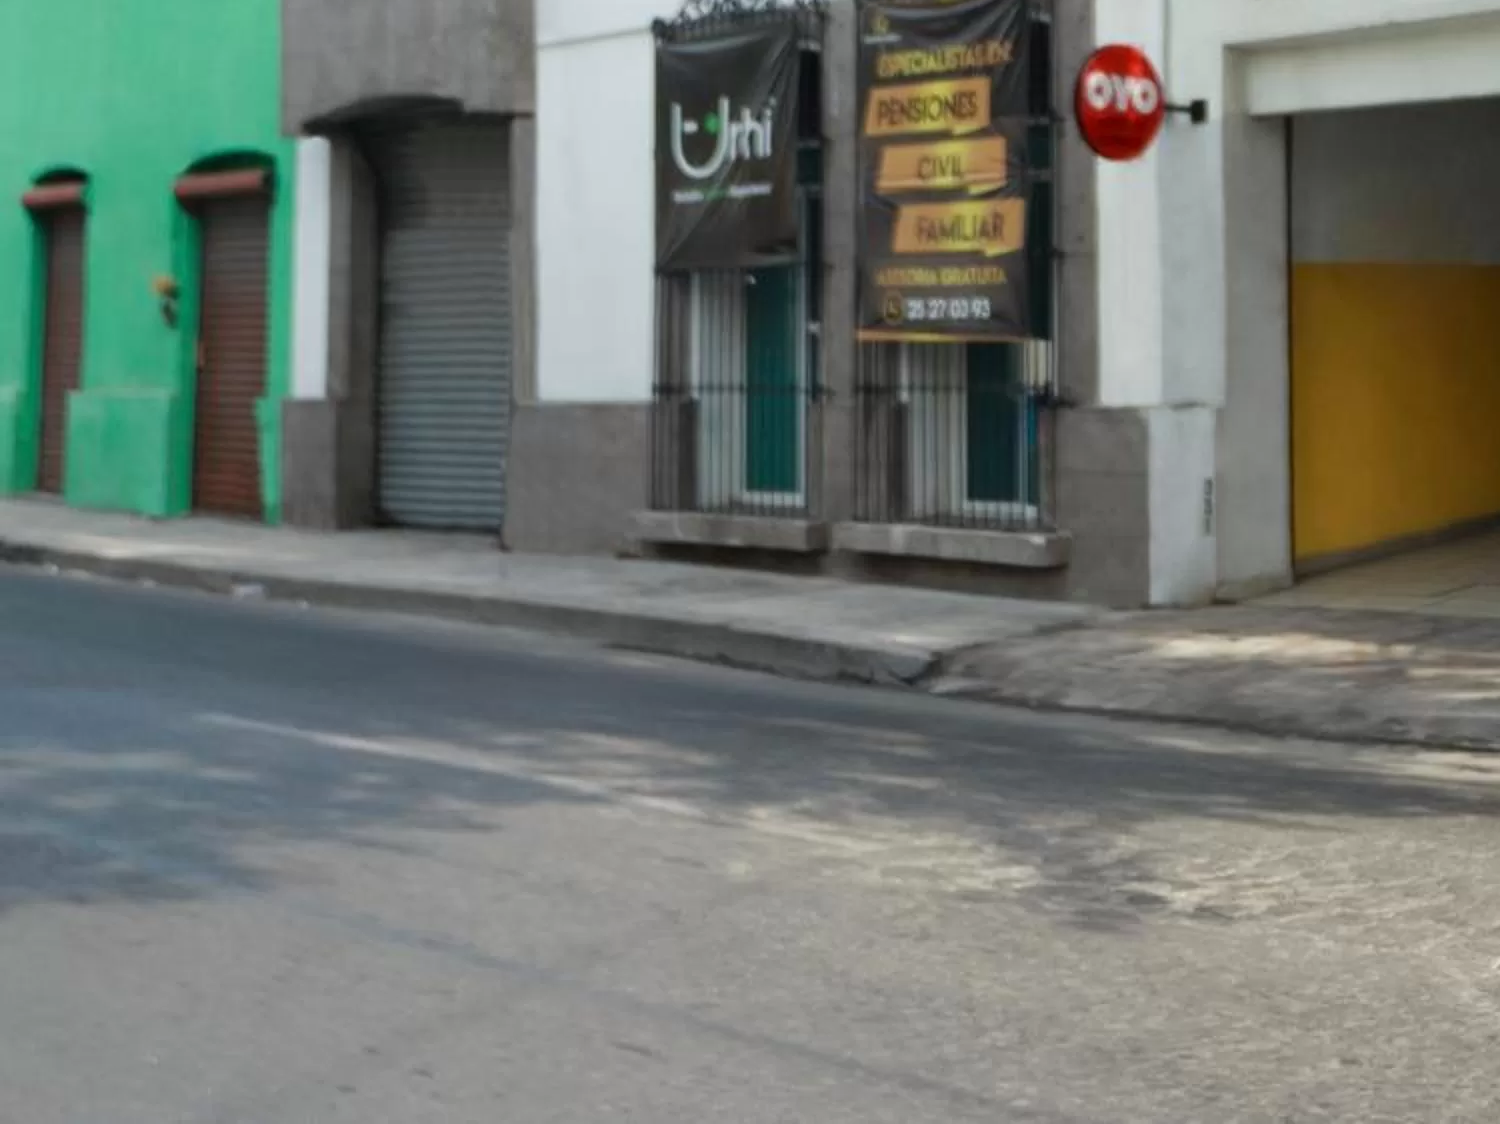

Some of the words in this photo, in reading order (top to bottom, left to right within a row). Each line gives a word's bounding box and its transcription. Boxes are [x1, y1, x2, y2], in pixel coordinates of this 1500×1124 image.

[876, 91, 978, 126] PENSIONES
[1086, 70, 1158, 114] OYO
[917, 155, 961, 179] CIVIL
[916, 210, 1005, 244] FAMILIAR
